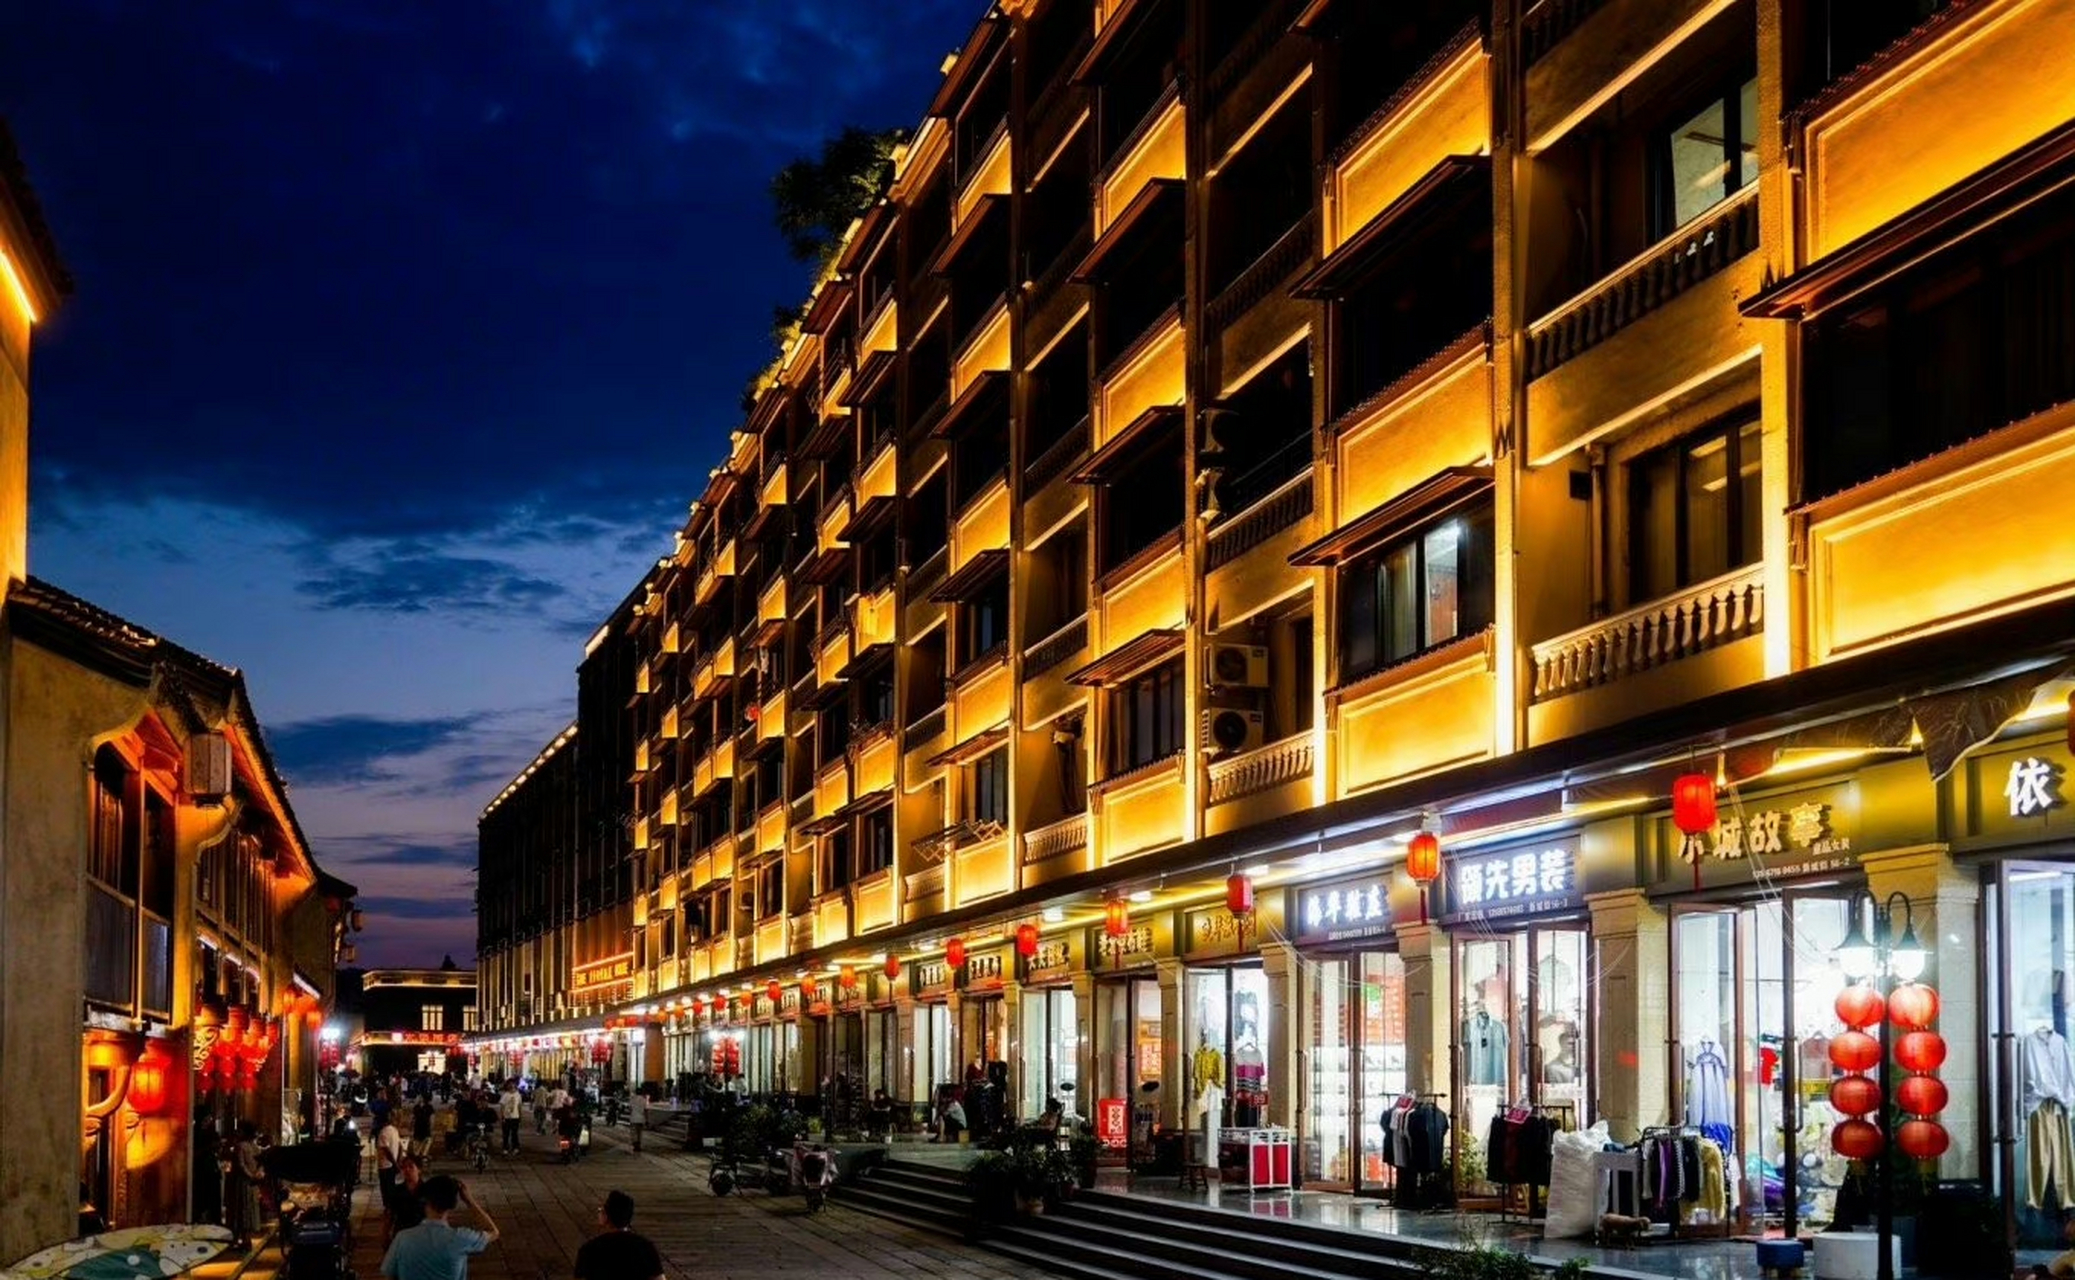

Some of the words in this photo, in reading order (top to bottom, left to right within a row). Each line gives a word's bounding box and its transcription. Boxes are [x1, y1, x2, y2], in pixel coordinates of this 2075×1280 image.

[2003, 757, 2053, 816] 依
[1678, 803, 1824, 864] 小城故事
